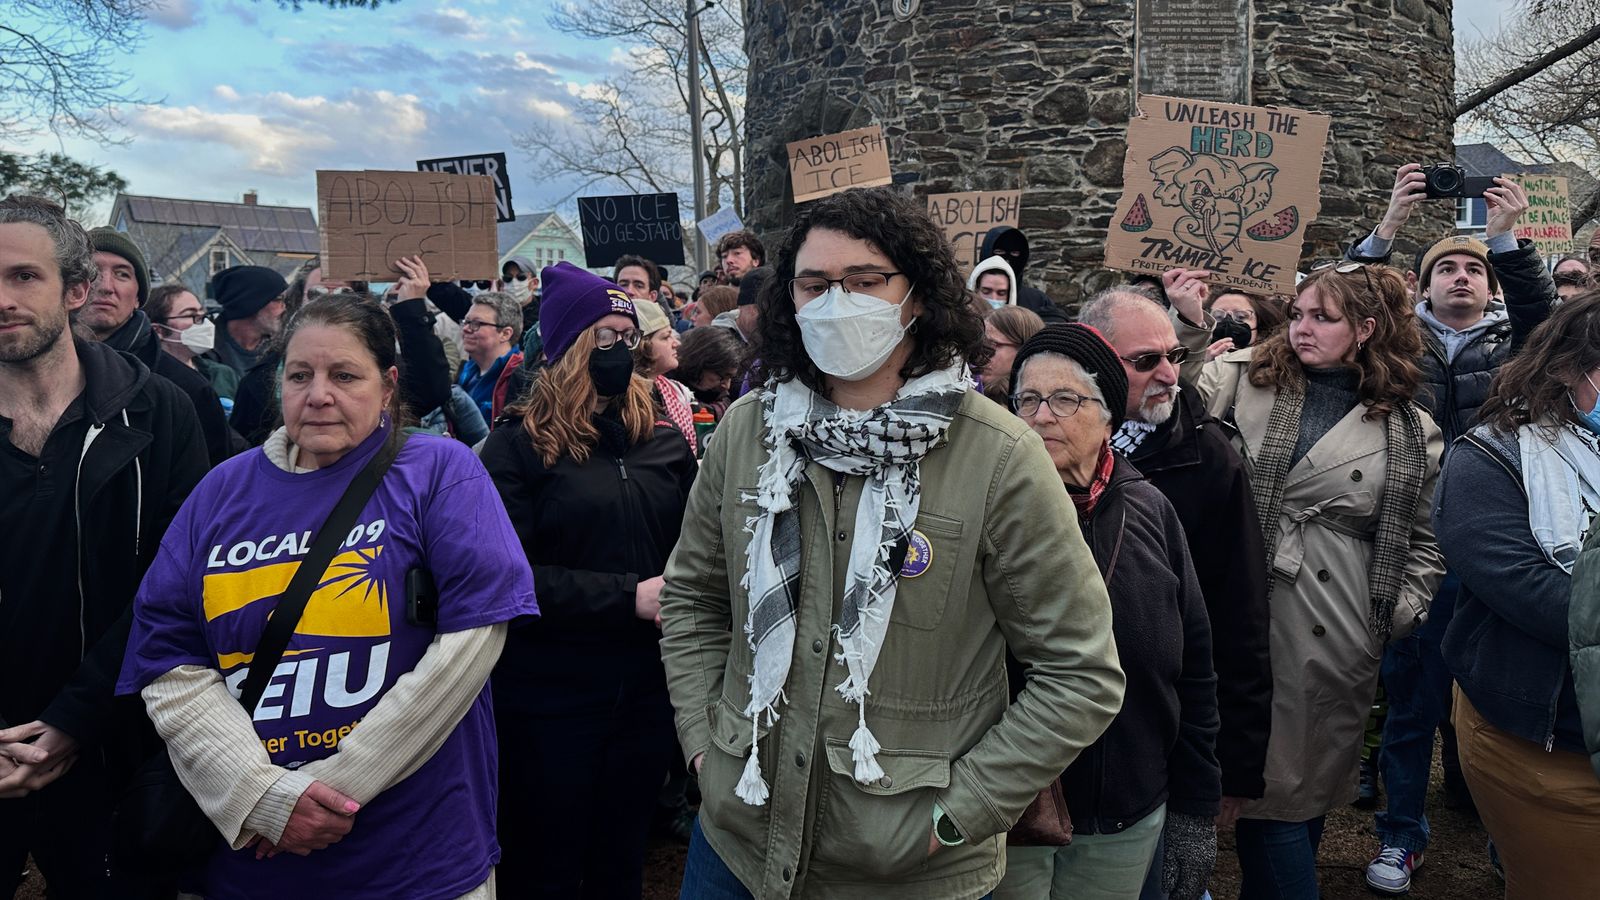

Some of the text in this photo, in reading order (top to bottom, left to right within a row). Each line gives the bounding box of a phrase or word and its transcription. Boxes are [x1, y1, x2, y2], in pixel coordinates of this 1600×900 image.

[1165, 101, 1300, 136] UNLEASH THE
[793, 133, 882, 171] ABOLISH
[1190, 126, 1273, 159] HERD
[421, 157, 503, 188] VER
[804, 163, 862, 193] ICE
[1524, 179, 1543, 192] MUST
[327, 175, 485, 229] ABOLISH
[580, 194, 671, 223] NO ICE
[929, 195, 1019, 226] ABOLISH
[1527, 195, 1550, 208] BRING
[1528, 210, 1538, 224] BE
[1541, 211, 1549, 225] A
[583, 223, 610, 248] NO
[615, 220, 682, 243] GESTAPO
[941, 227, 988, 268] CE
[354, 232, 444, 276] ICE
[1140, 236, 1281, 283] TRAMPLE ICE
[1131, 258, 1176, 273] PROTEC
[1225, 275, 1279, 291] STUDENTS!
[611, 300, 632, 310] SEIU
[207, 519, 385, 568] LOCAL 09
[912, 535, 929, 564] TOGETHER
[294, 720, 358, 749] Toge
